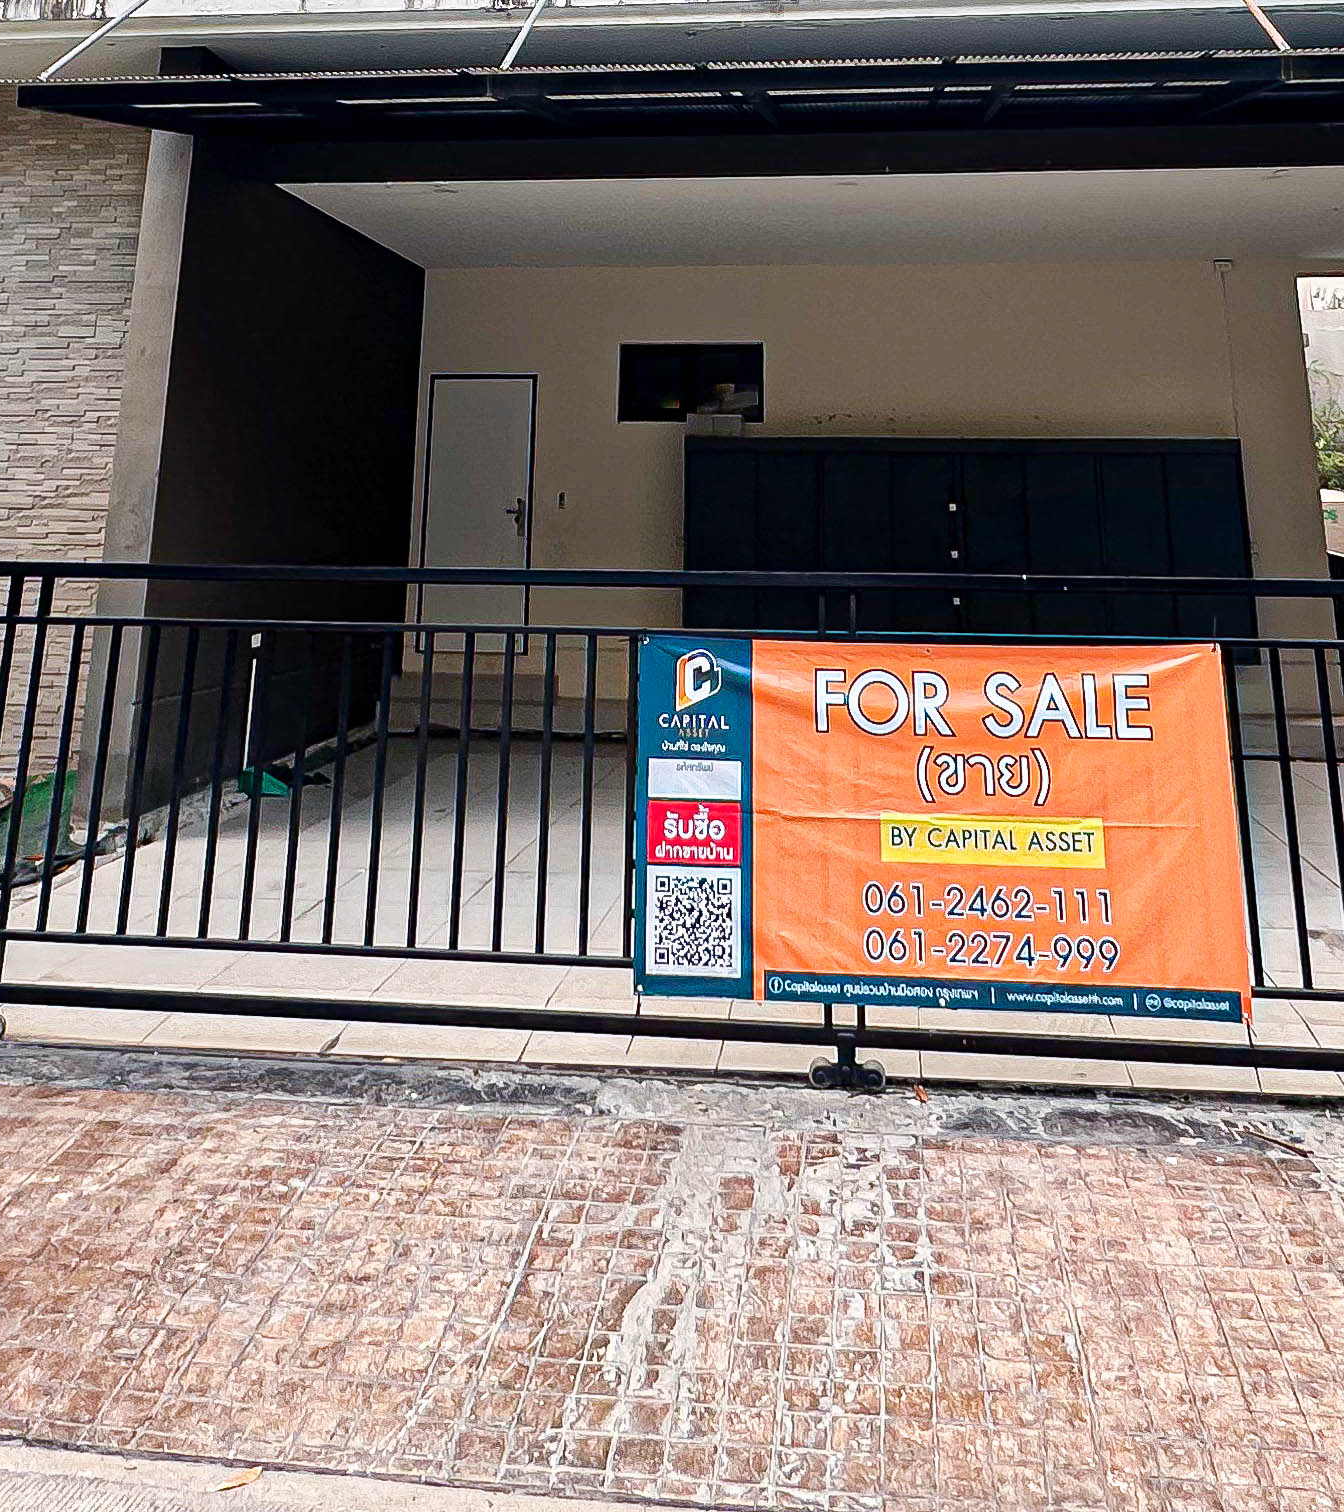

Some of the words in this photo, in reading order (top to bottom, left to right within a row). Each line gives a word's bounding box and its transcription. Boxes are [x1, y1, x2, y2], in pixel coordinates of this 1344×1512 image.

[659, 713, 730, 730] CAPITAL
[815, 668, 956, 737] FOR
[982, 672, 1154, 740] SALE
[679, 729, 710, 738] ASSET
[917, 745, 1052, 806] (ขาย)
[663, 803, 726, 841] รับซื้อ
[890, 826, 918, 847] BY
[927, 827, 1018, 851] CAPITAL
[1028, 831, 1095, 853] ASSET
[655, 840, 734, 861] ฝากขายบ้าน
[863, 880, 1113, 925] 061-2462-111
[864, 926, 1121, 973] 061-2274-999
